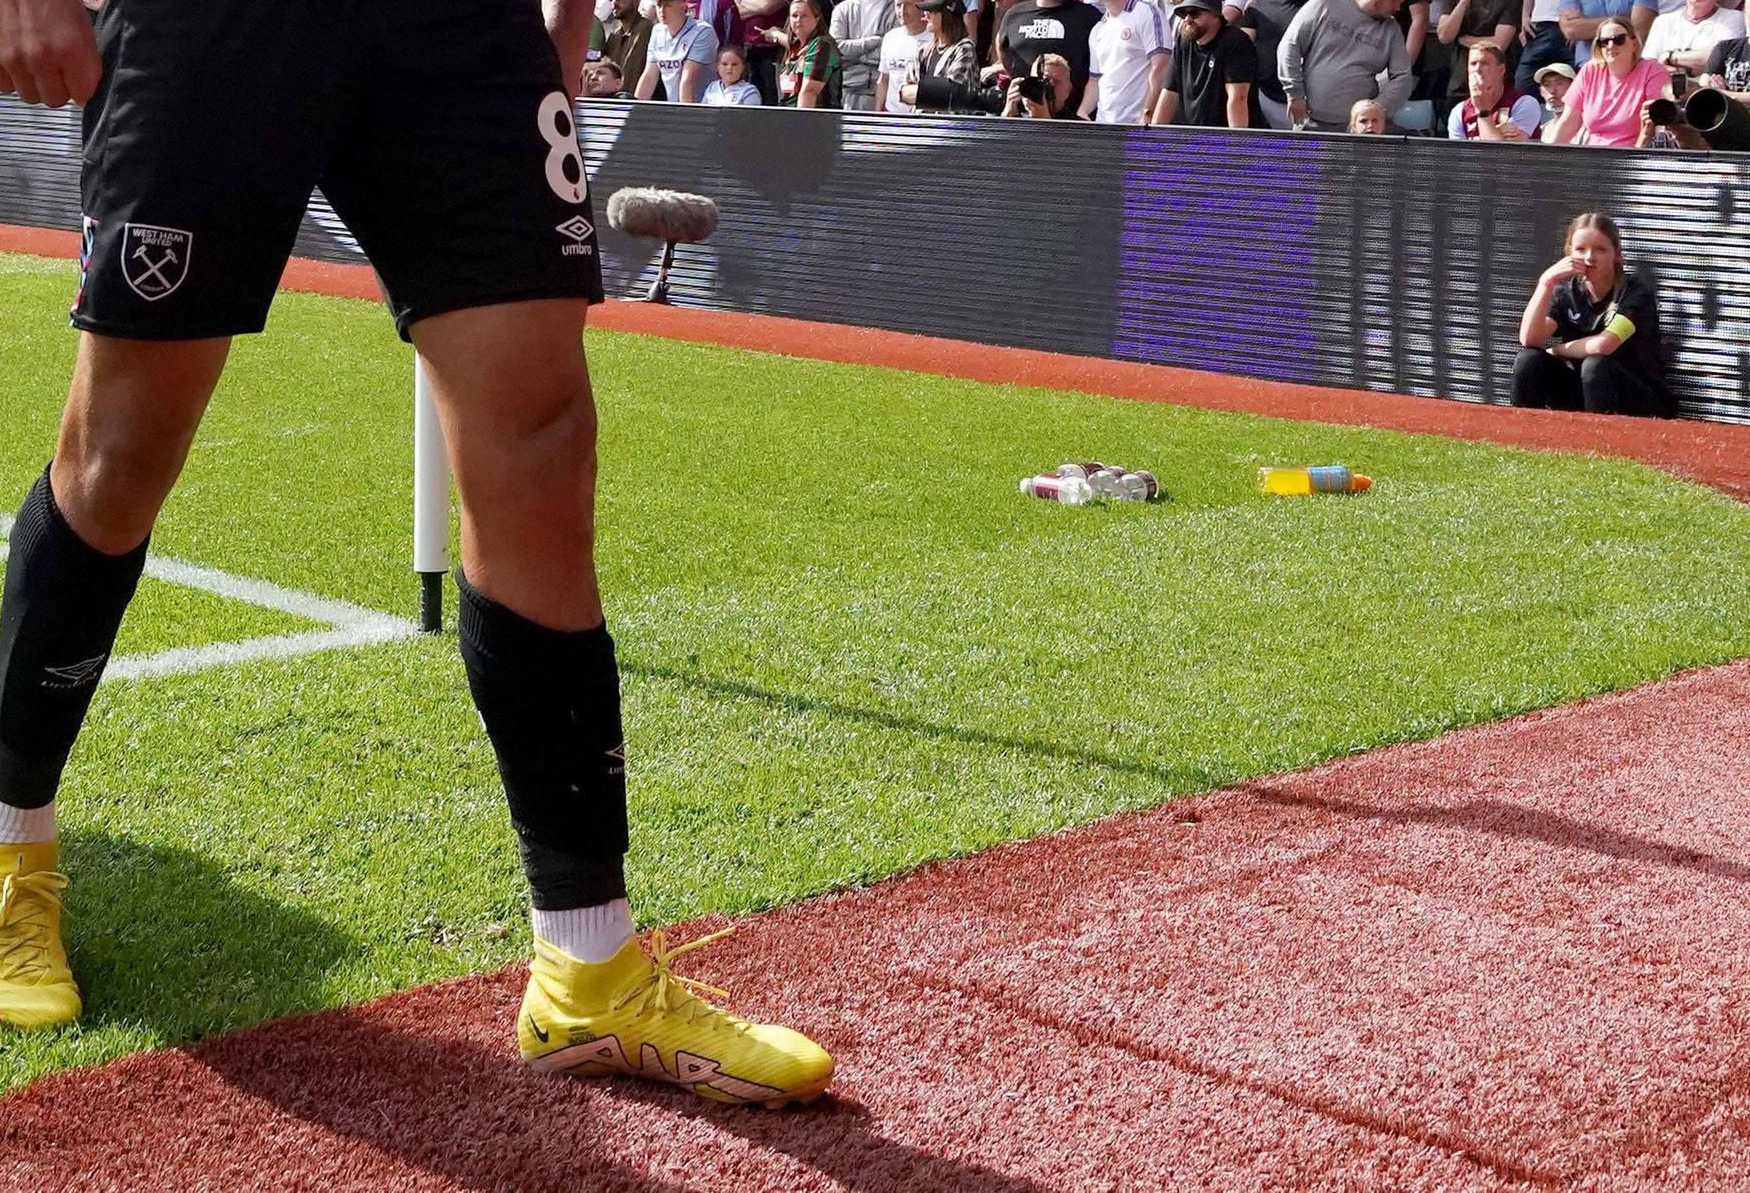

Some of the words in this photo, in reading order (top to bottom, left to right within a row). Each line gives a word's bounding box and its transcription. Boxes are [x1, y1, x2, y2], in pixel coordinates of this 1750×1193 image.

[537, 91, 587, 204] 8
[132, 228, 159, 238] WEST
[159, 231, 184, 243] HAM
[561, 243, 593, 256] umbro
